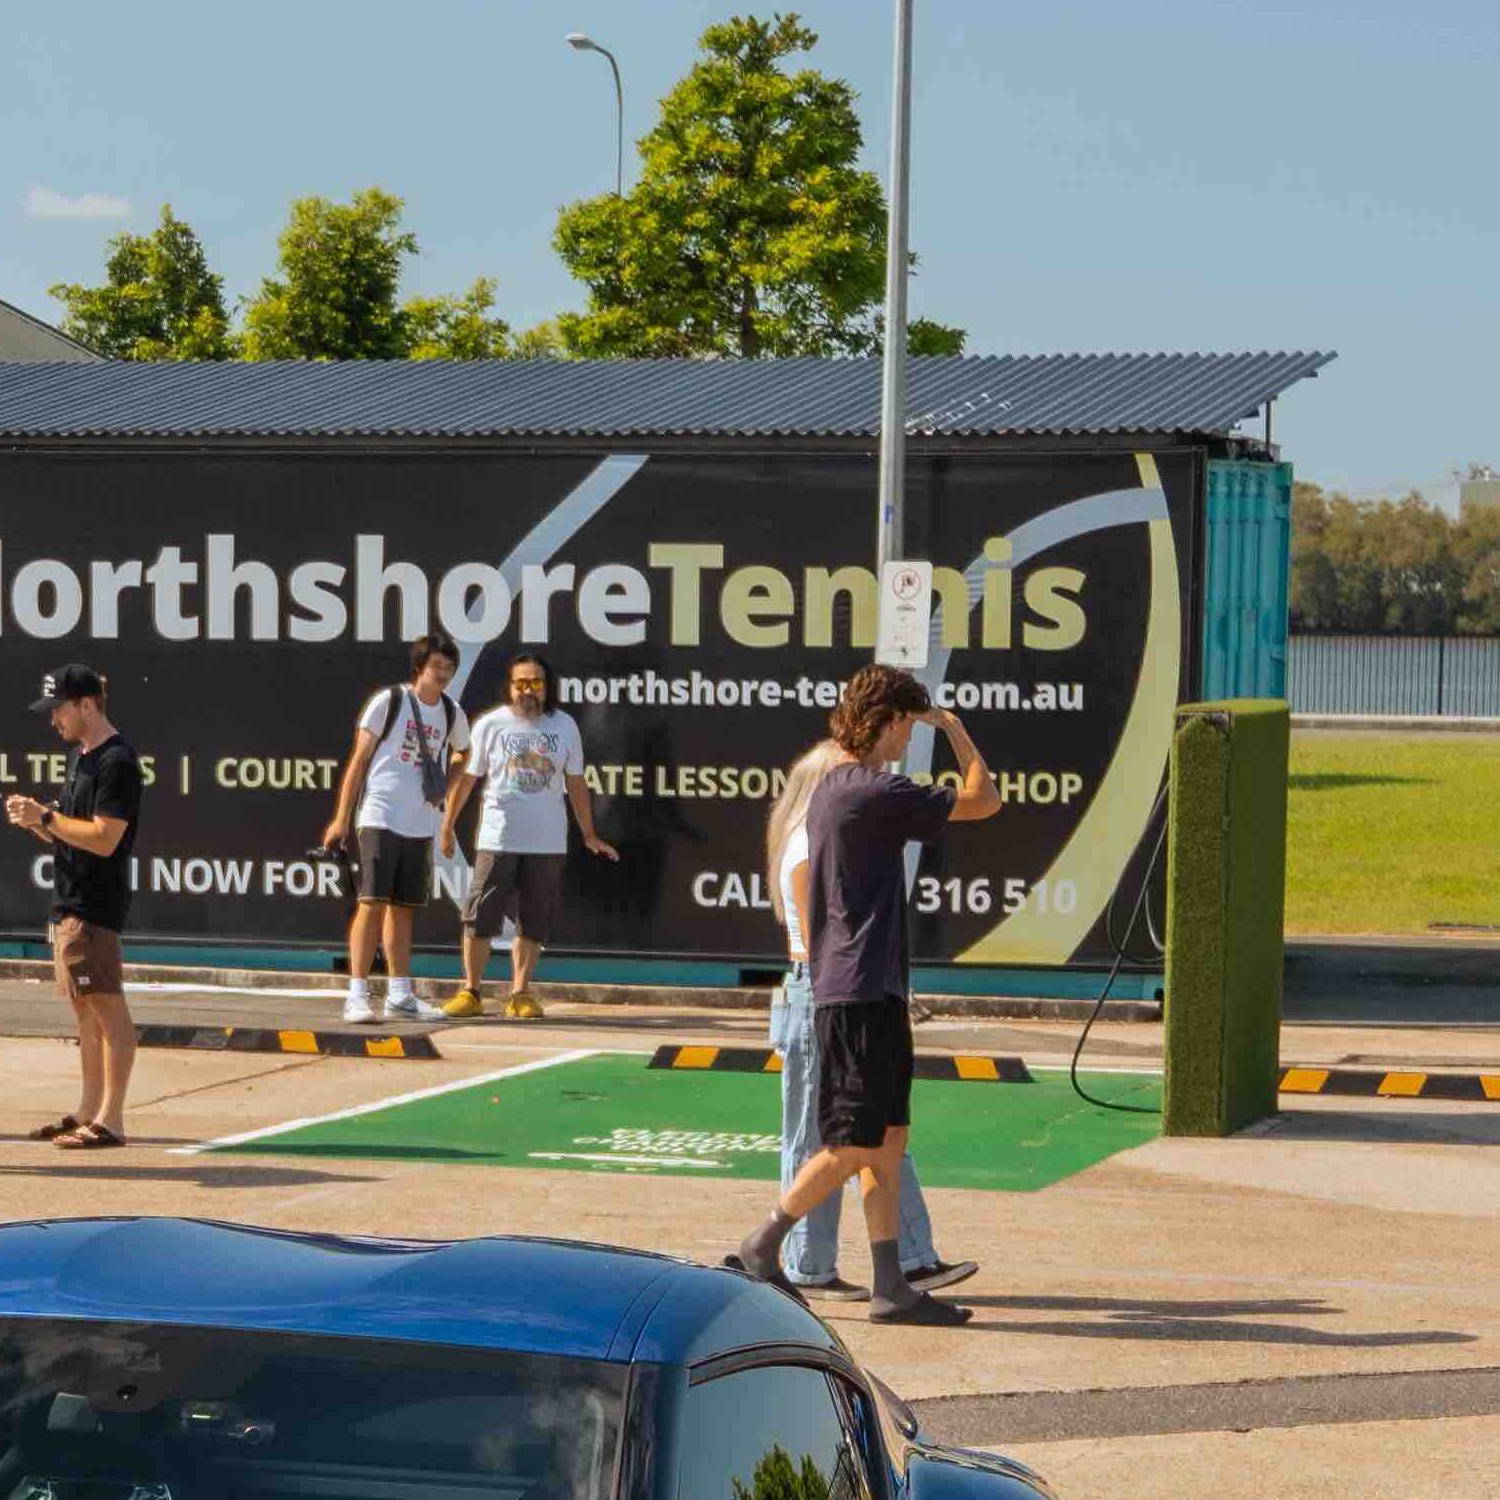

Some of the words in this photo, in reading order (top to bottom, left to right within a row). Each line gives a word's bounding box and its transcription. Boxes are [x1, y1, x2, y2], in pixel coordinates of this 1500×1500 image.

[216, 757, 339, 790] COURT
[655, 764, 790, 799] LESSON
[989, 771, 1083, 805] HOP
[152, 856, 253, 895] NOW
[265, 859, 343, 897] FOR
[692, 871, 772, 908] CAL
[916, 876, 992, 914] 316
[1004, 877, 1077, 914] 510
